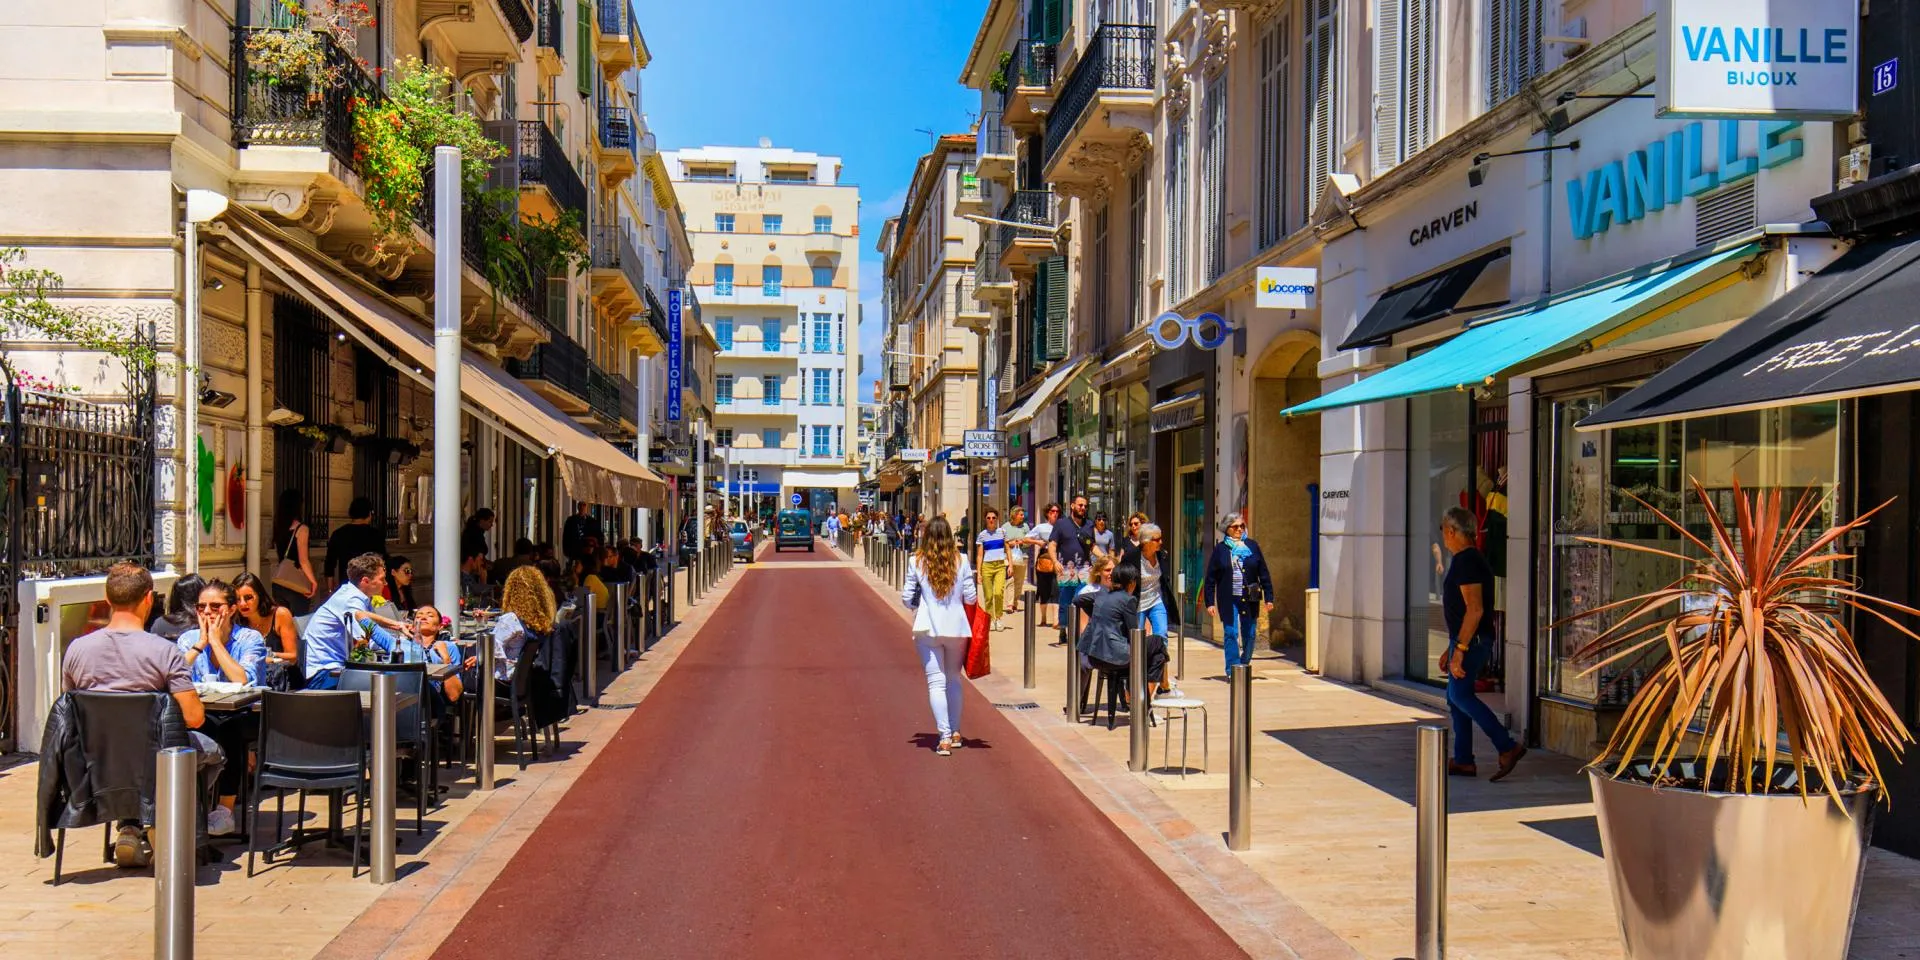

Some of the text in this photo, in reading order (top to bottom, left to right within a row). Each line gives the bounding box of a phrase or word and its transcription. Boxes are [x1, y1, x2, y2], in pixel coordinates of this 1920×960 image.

[1681, 25, 1848, 64] VANILLE
[1727, 71, 1797, 86] BIJOUX
[1876, 64, 1893, 92] 15
[1566, 120, 1804, 241] VANILLE
[1409, 200, 1478, 247] CARVEN
[1267, 283, 1315, 295] LOCOPRO
[670, 292, 680, 419] HOTEL FLORIAN
[967, 441, 1004, 450] CROISETTE
[972, 432, 1000, 440] VILLAGE
[1322, 489, 1350, 499] CARVEN
